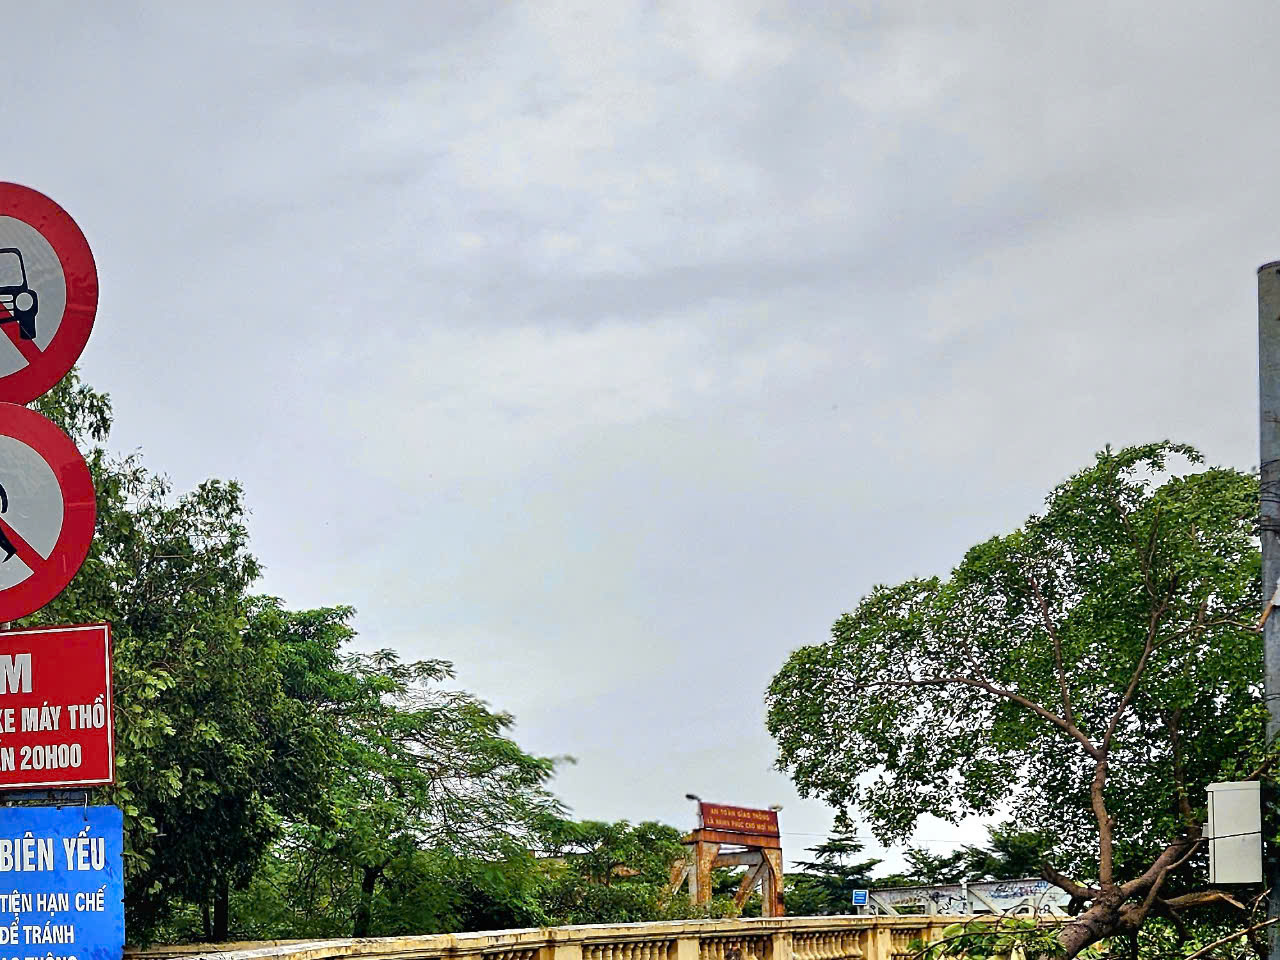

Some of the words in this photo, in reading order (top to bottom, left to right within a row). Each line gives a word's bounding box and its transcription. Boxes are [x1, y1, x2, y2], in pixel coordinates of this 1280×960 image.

[21, 701, 62, 732] MÁY
[68, 693, 105, 730] THỒ
[20, 743, 82, 771] 20H00
[0, 831, 54, 872] BIÊN
[62, 825, 105, 871] YẾU
[0, 889, 33, 917] TIỆN
[36, 893, 69, 917] HẠN
[74, 884, 107, 912] CHẾ
[23, 920, 75, 945] TRÁNH
